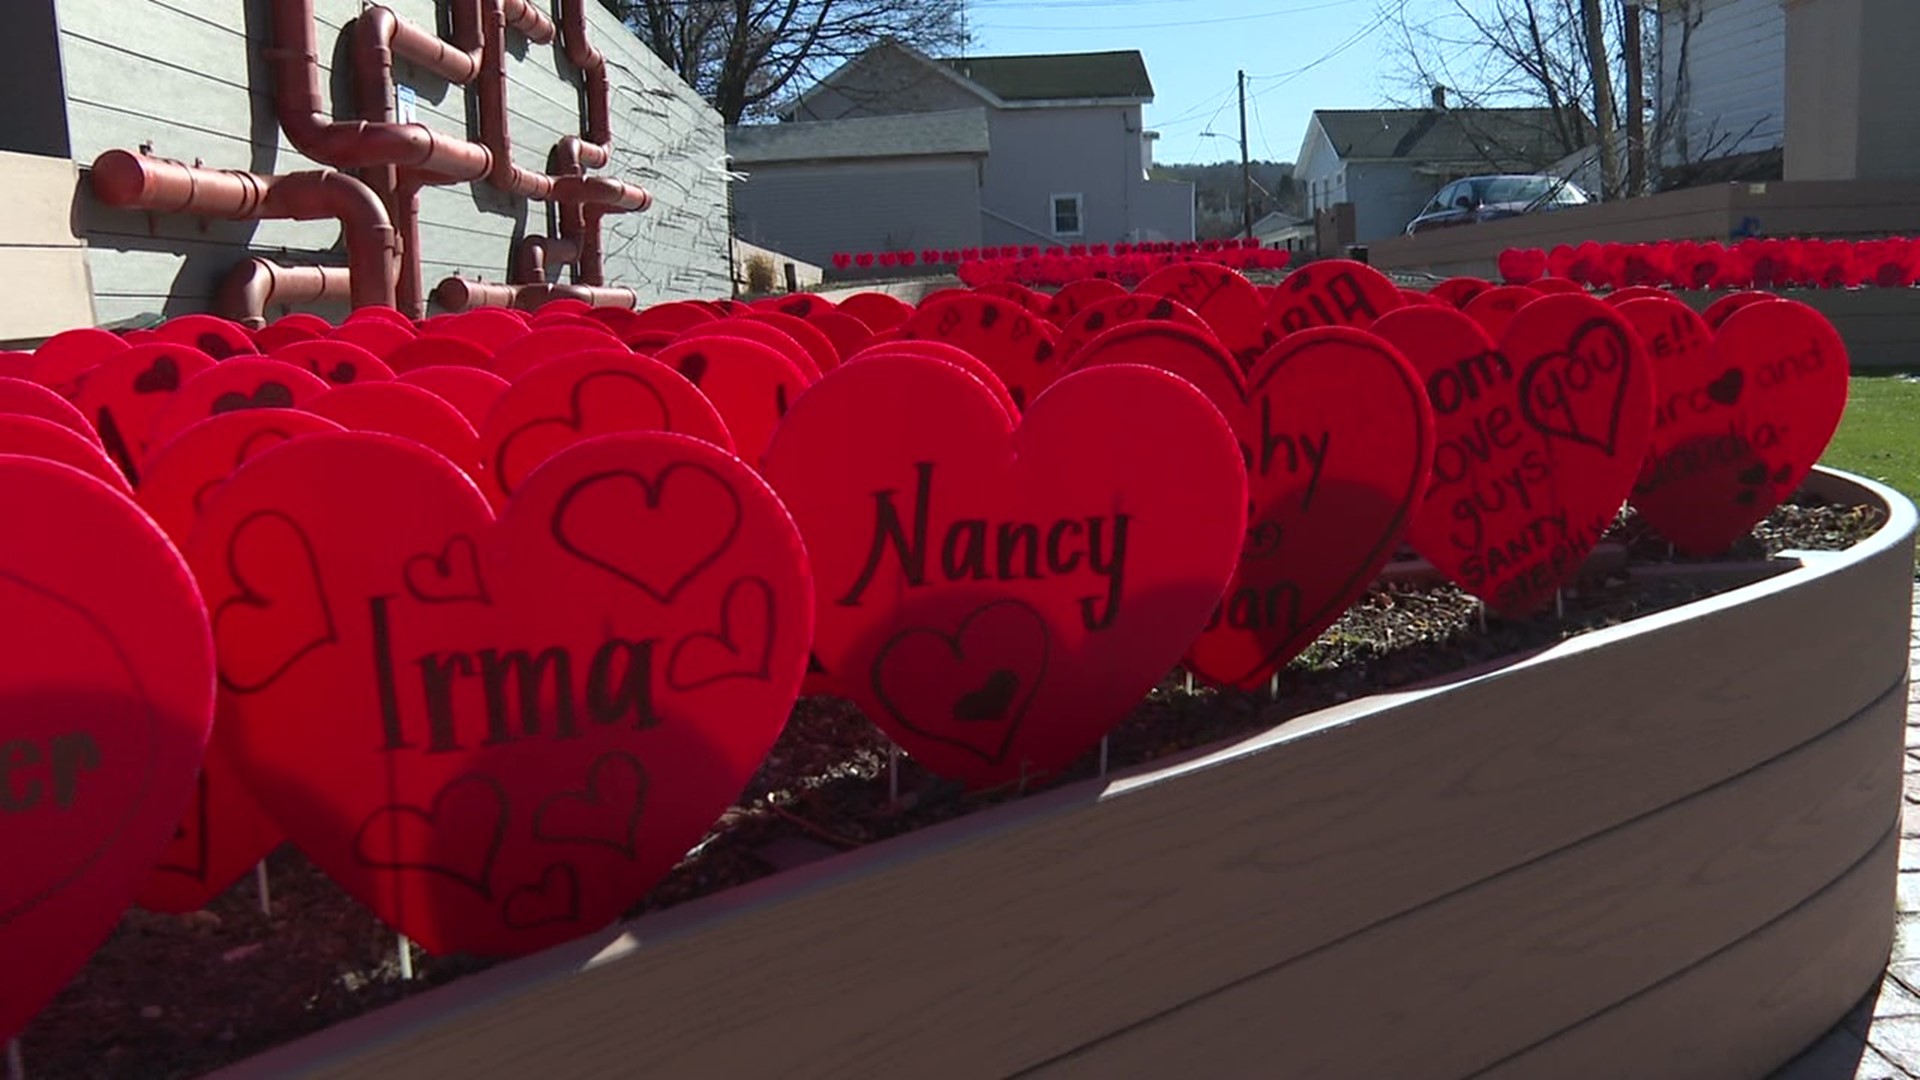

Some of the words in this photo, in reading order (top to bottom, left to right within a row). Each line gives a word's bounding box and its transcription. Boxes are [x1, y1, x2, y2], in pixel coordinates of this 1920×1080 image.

[1534, 338, 1619, 434] you
[1756, 337, 1826, 390] and
[835, 462, 1133, 633] Nancy
[1451, 449, 1551, 551] guys
[370, 595, 661, 754] Irma
